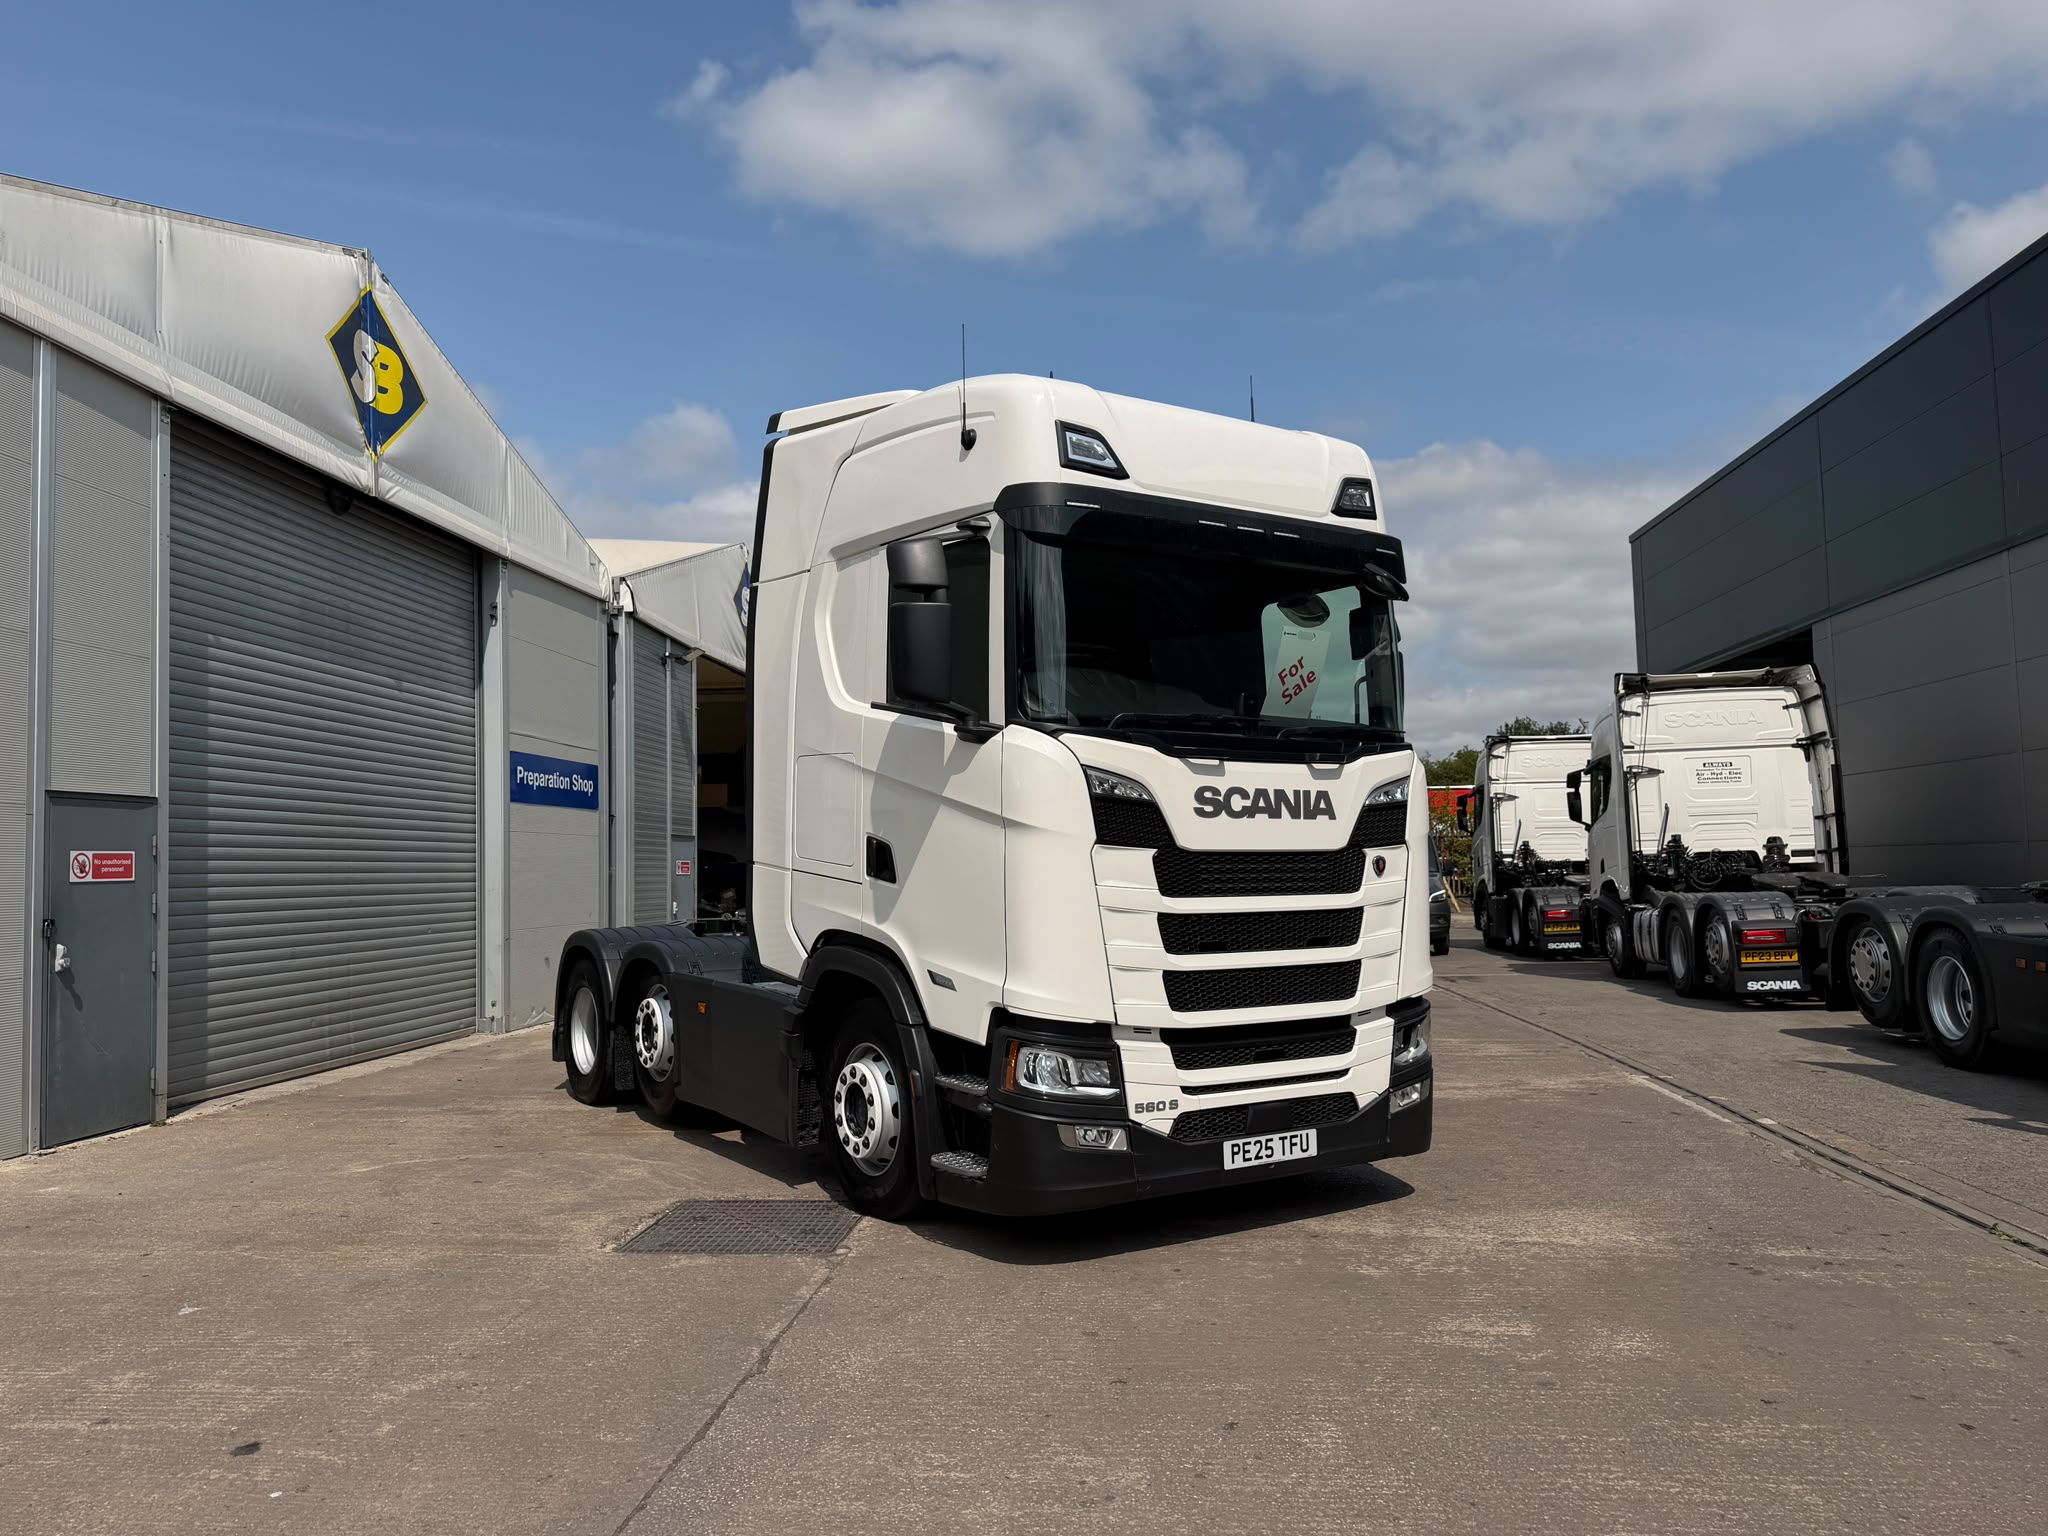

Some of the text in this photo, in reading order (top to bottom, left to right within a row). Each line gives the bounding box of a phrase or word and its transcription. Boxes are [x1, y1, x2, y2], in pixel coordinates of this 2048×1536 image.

[350, 328, 404, 415] SB
[1278, 656, 1305, 686] For
[1281, 670, 1317, 705] Sale
[1664, 711, 1763, 728] SCANIA
[517, 766, 594, 796] Preparation Shop
[1193, 785, 1337, 820] SCANIA
[1547, 941, 1582, 949] SCANIA
[1746, 980, 1801, 990] SCANIA
[1134, 1099, 1179, 1114] 560 S
[1231, 1132, 1310, 1164] PE25 TFU
